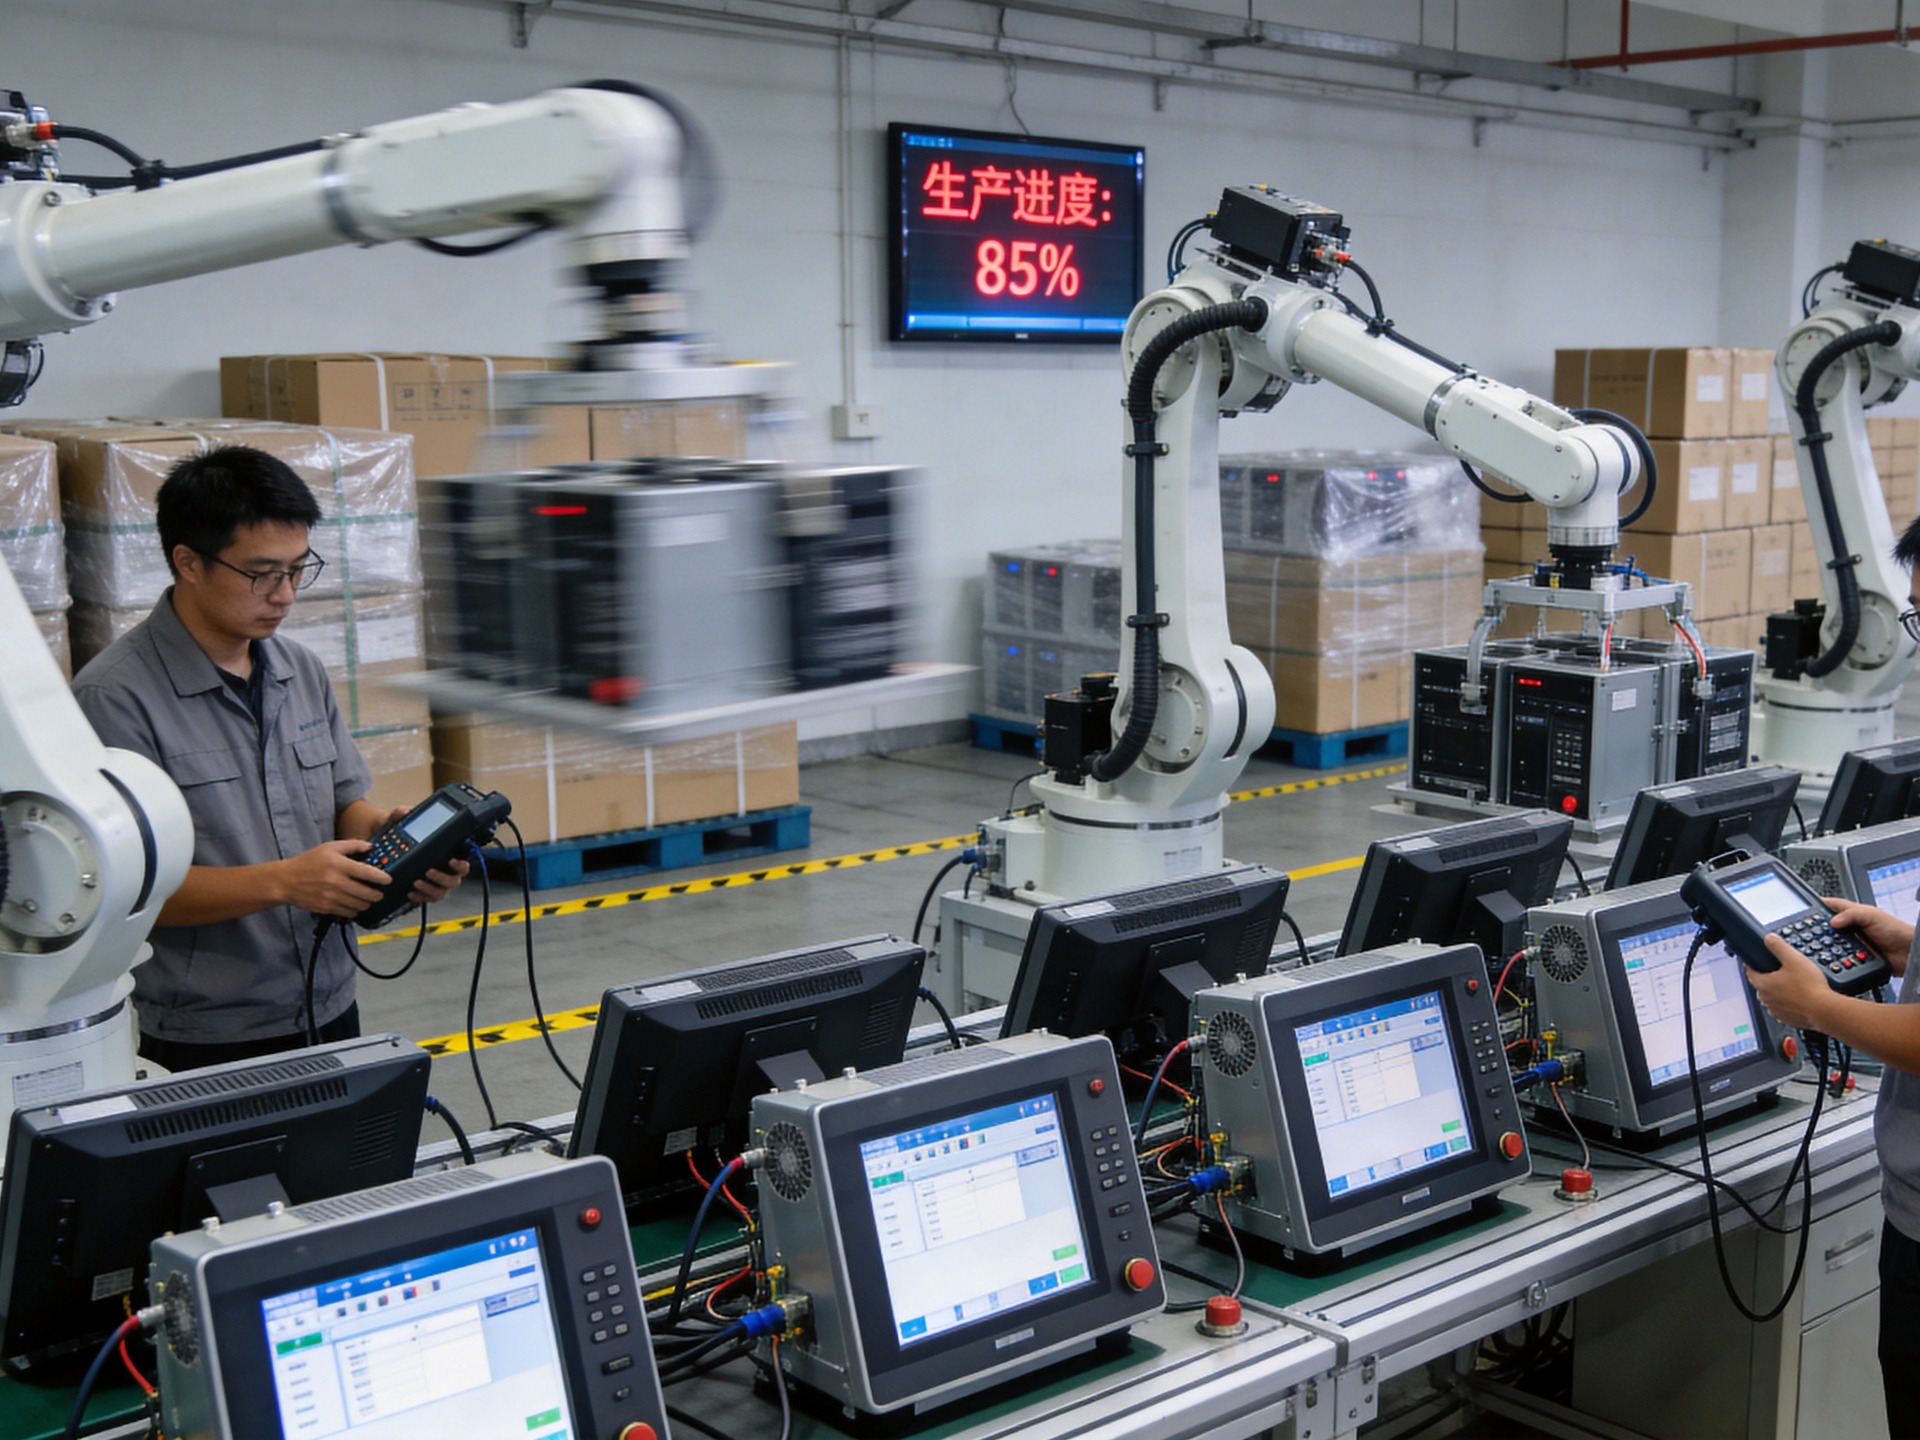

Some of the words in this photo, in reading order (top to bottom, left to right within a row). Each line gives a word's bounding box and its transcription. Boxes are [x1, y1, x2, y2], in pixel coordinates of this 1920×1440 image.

[922, 160, 1112, 228] 生产进度：
[975, 238, 1081, 299] 85%
